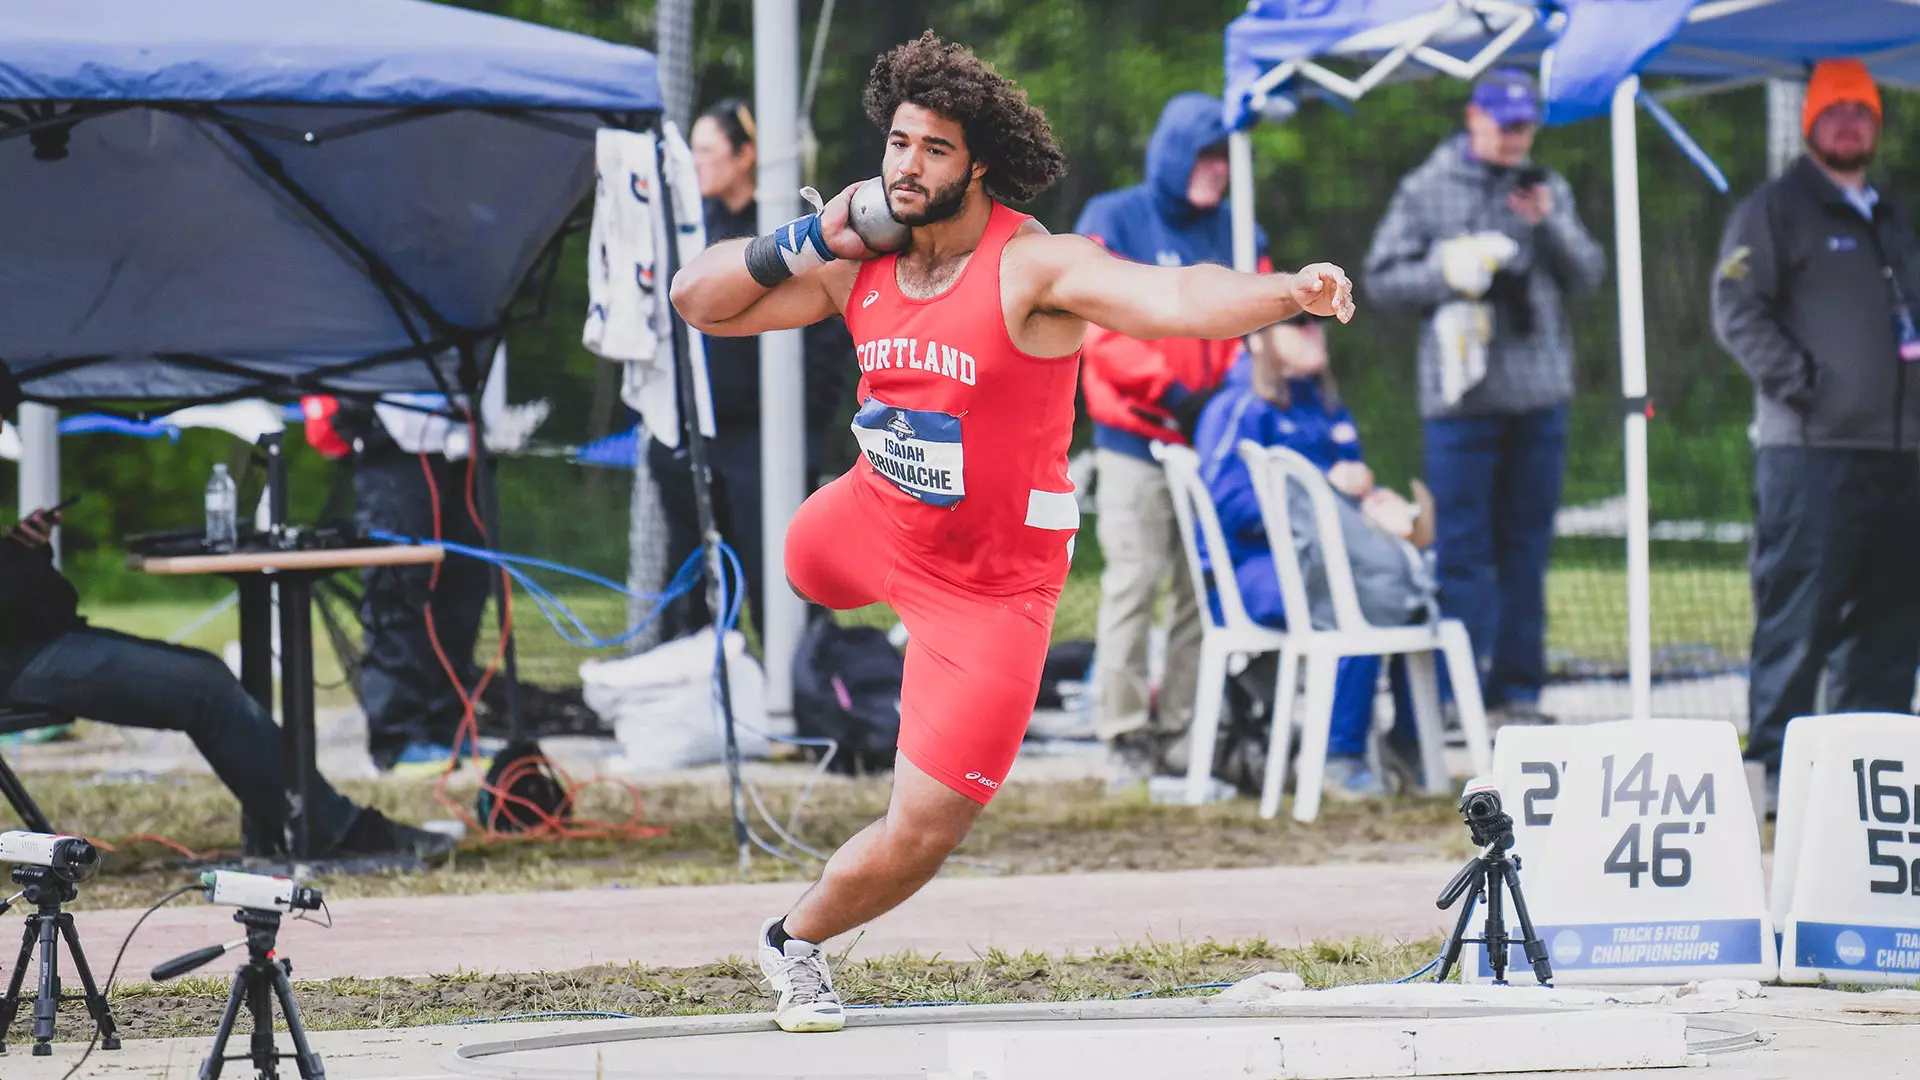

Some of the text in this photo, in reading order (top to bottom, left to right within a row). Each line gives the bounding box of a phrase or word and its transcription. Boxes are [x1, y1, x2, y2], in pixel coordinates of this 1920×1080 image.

[856, 337, 976, 386] CORTLAND
[866, 449, 952, 490] BRUNACHE
[884, 438, 925, 463] ISAIAH
[1601, 752, 1716, 818] 14M
[1853, 758, 1920, 825] 16
[1603, 821, 1706, 888] 46'
[1591, 941, 1720, 964] CHAMPIONSHIPS
[1612, 925, 1701, 943] TRACK & FIELD
[1895, 932, 1920, 949] TRA
